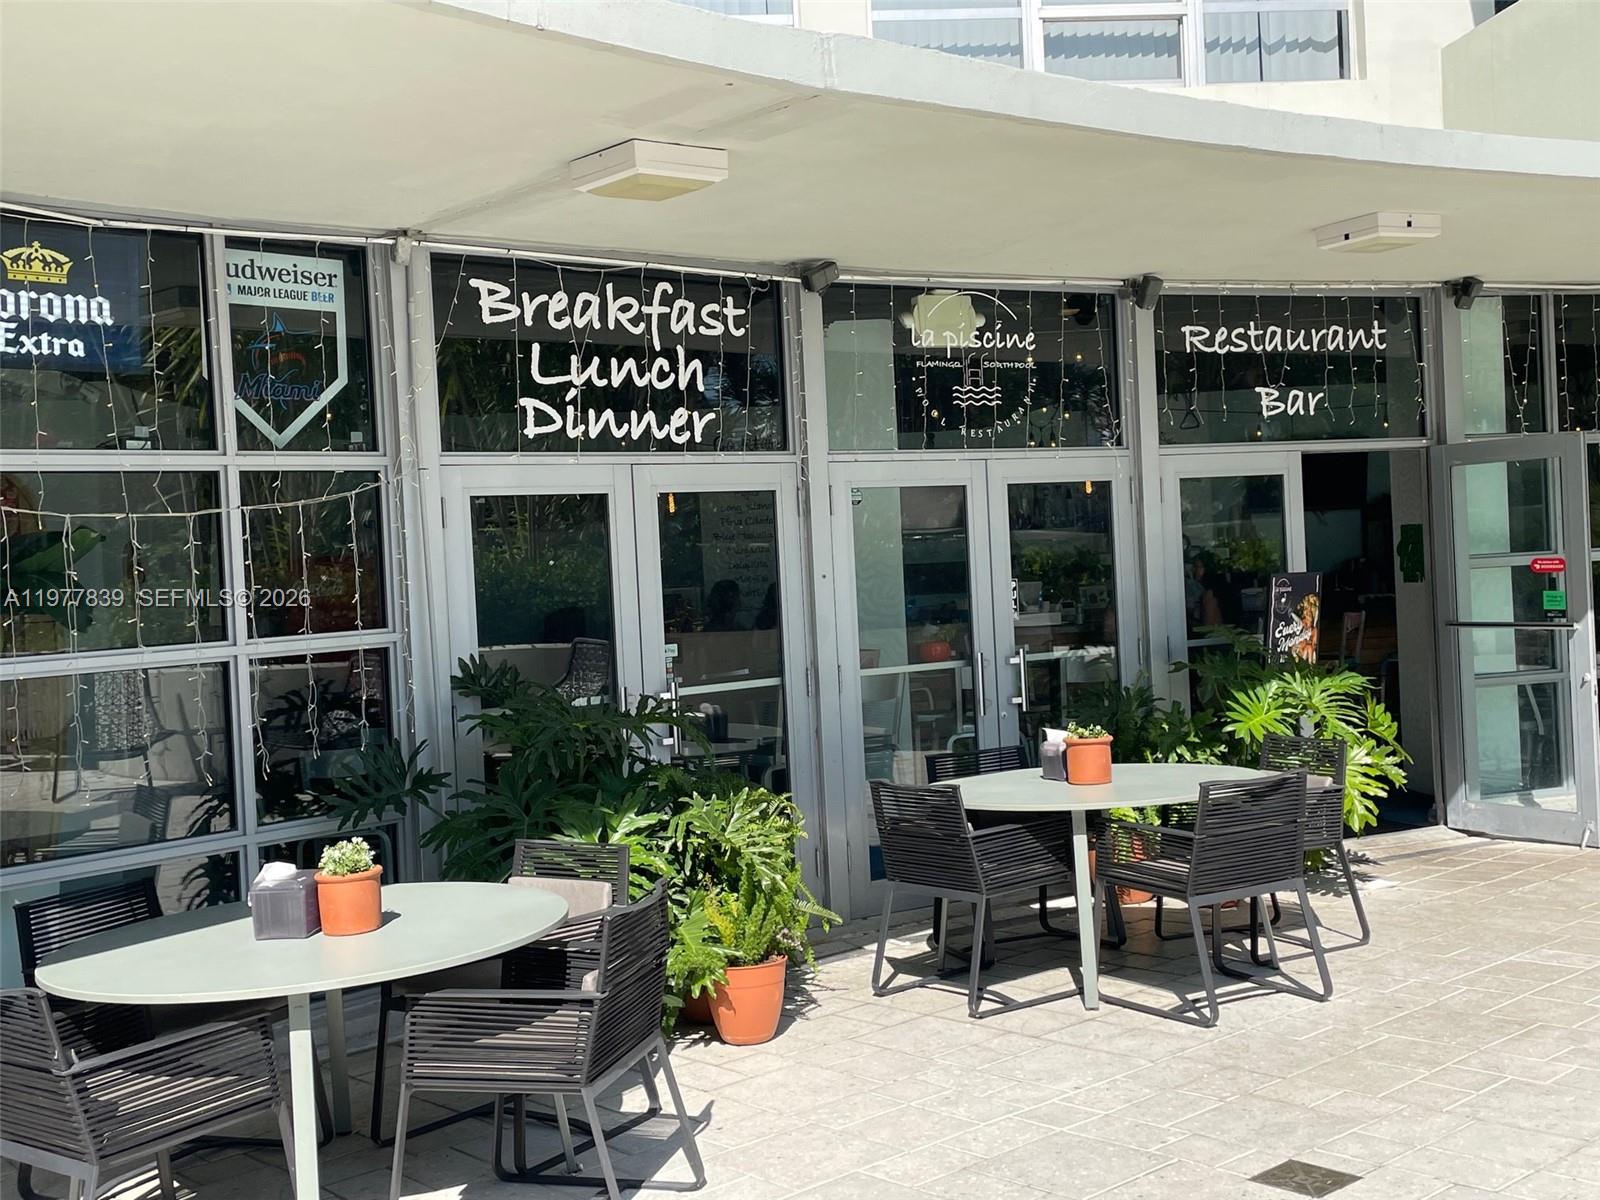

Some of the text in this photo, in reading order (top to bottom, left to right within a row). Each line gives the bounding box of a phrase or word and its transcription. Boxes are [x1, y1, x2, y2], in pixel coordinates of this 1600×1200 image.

[237, 284, 335, 303] MAJOR LEAGUE BEER
[468, 278, 747, 352] Breakfast
[0, 321, 86, 358] Extra
[943, 322, 1037, 359] piscine
[1181, 320, 1388, 353] Restaurant
[531, 342, 705, 392] Lunch
[916, 360, 963, 368] FLAMINGO
[234, 371, 322, 401] Miami
[1255, 386, 1325, 416] Bar
[519, 387, 716, 444] Dinner
